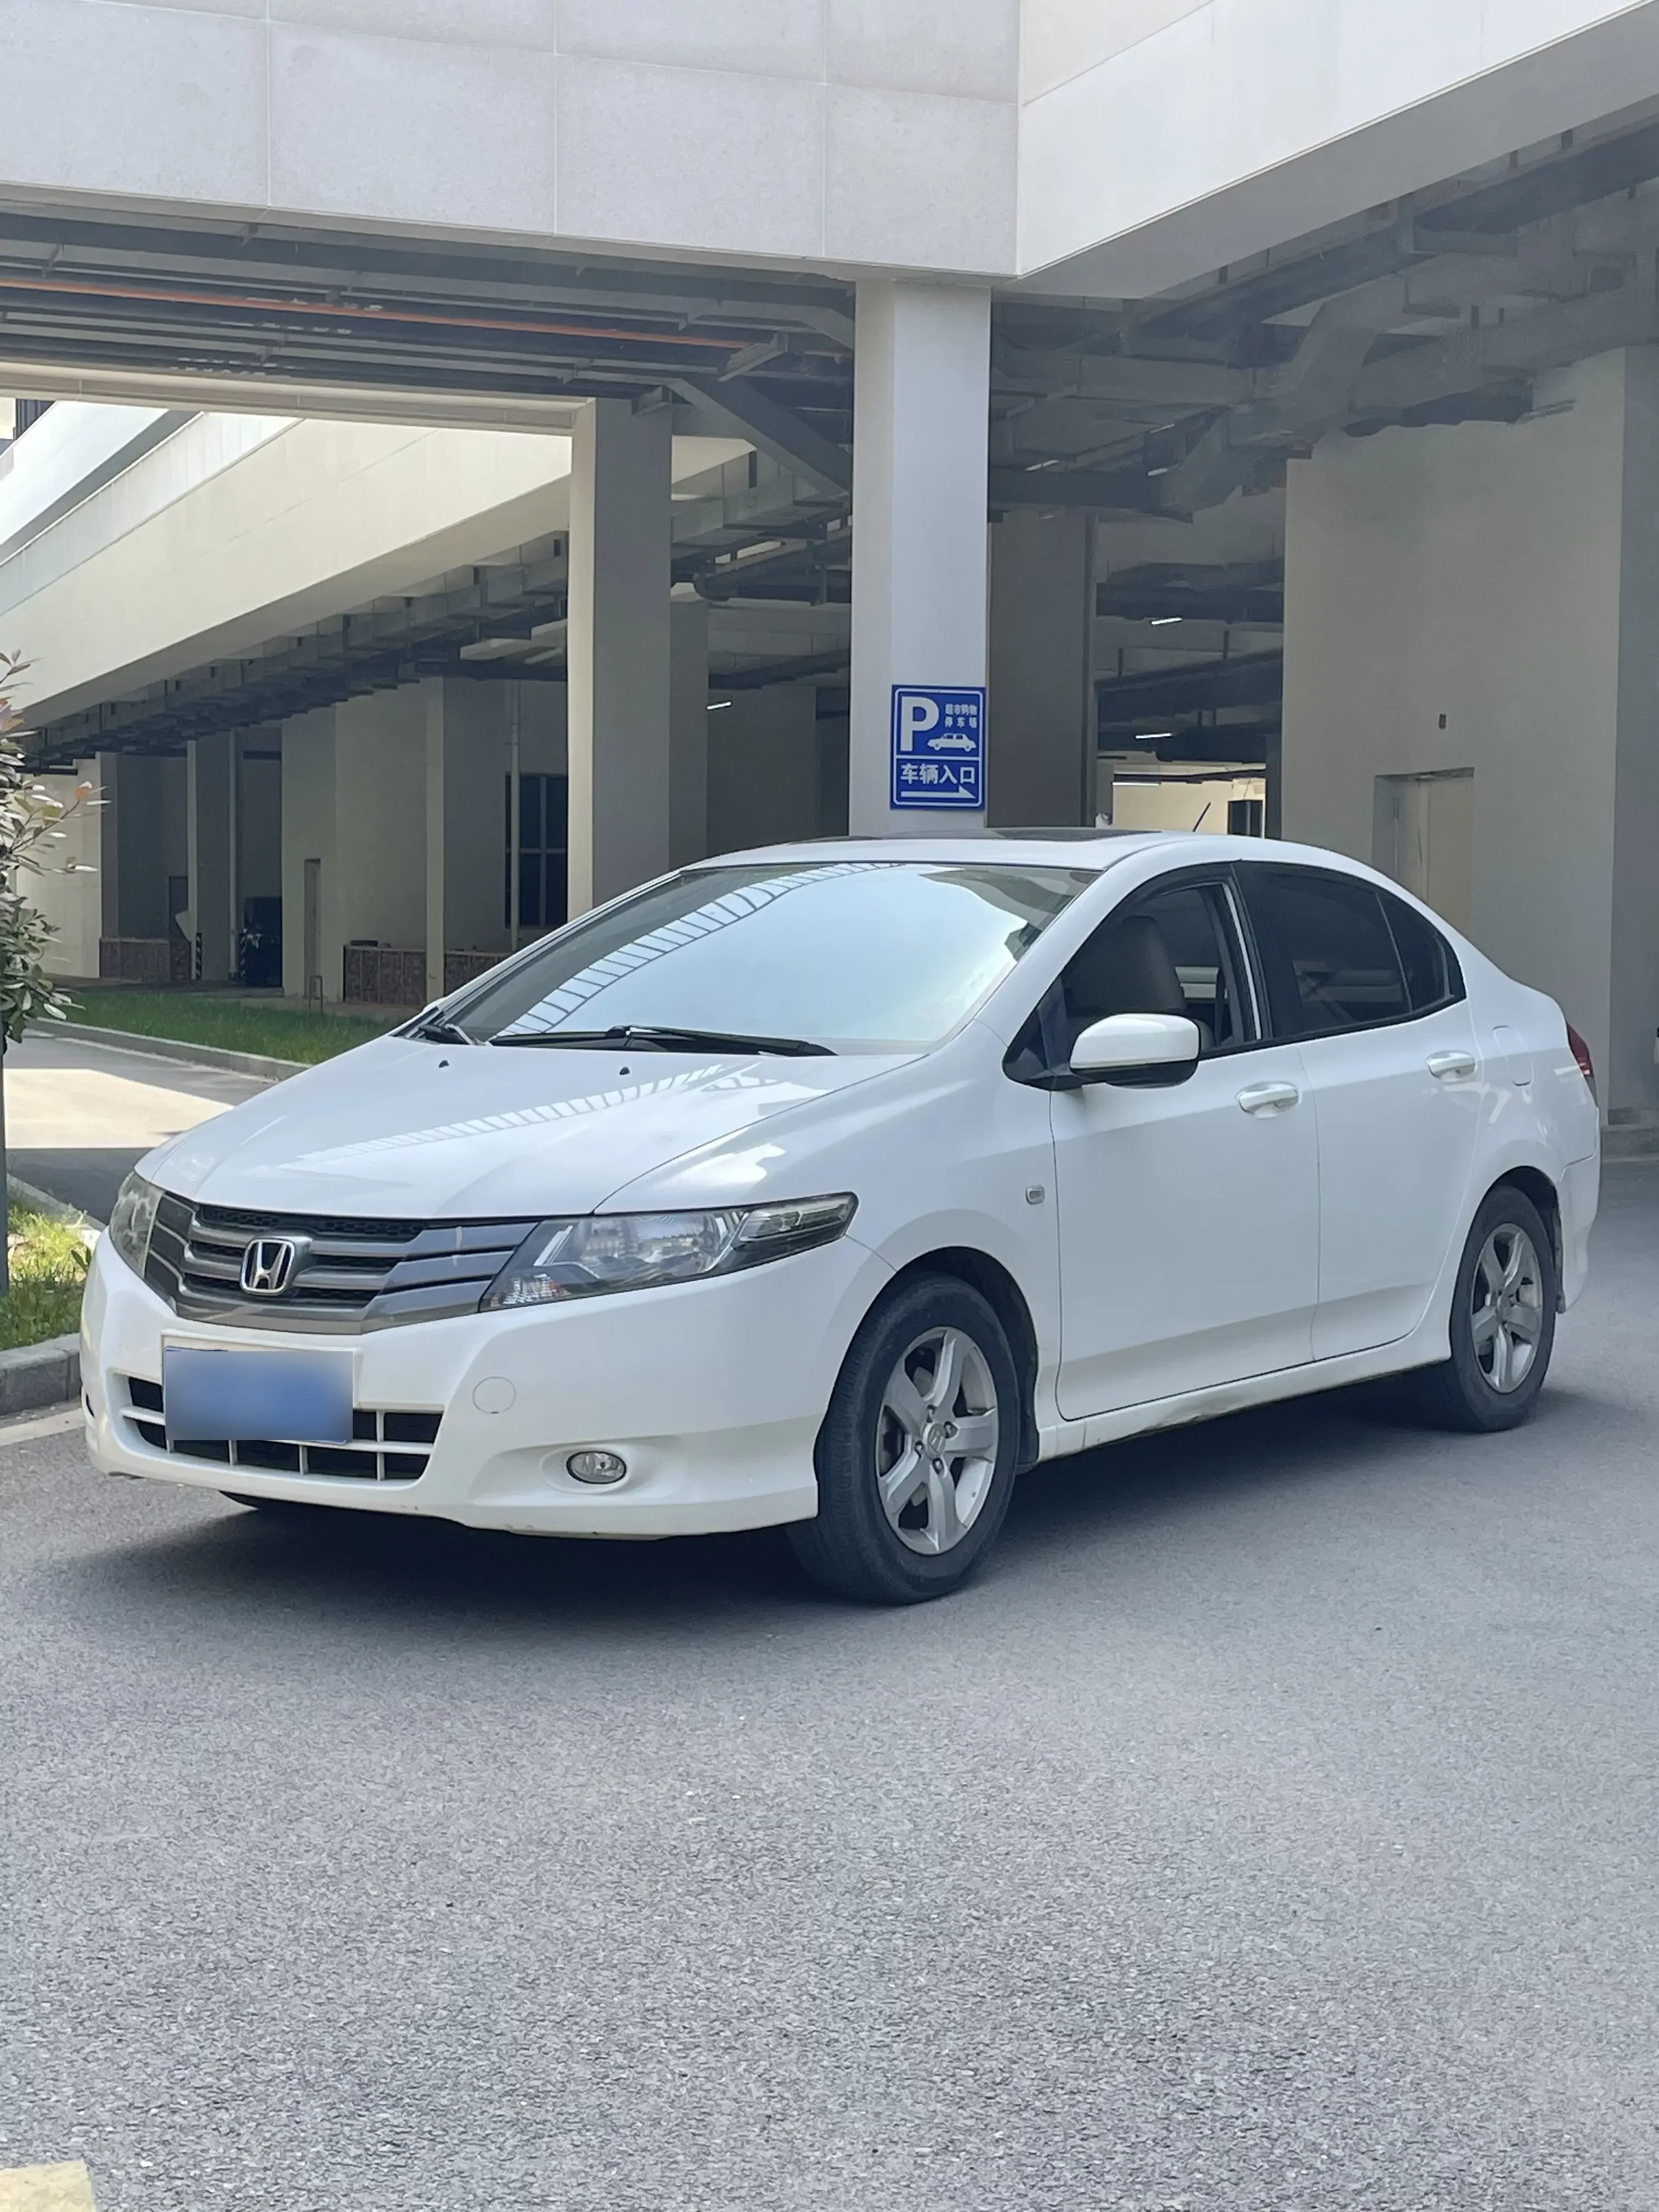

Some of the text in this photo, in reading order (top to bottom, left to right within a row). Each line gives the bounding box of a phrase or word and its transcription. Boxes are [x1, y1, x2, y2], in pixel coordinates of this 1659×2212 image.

[900, 696, 939, 752] P
[900, 763, 975, 785] 车辆入口
